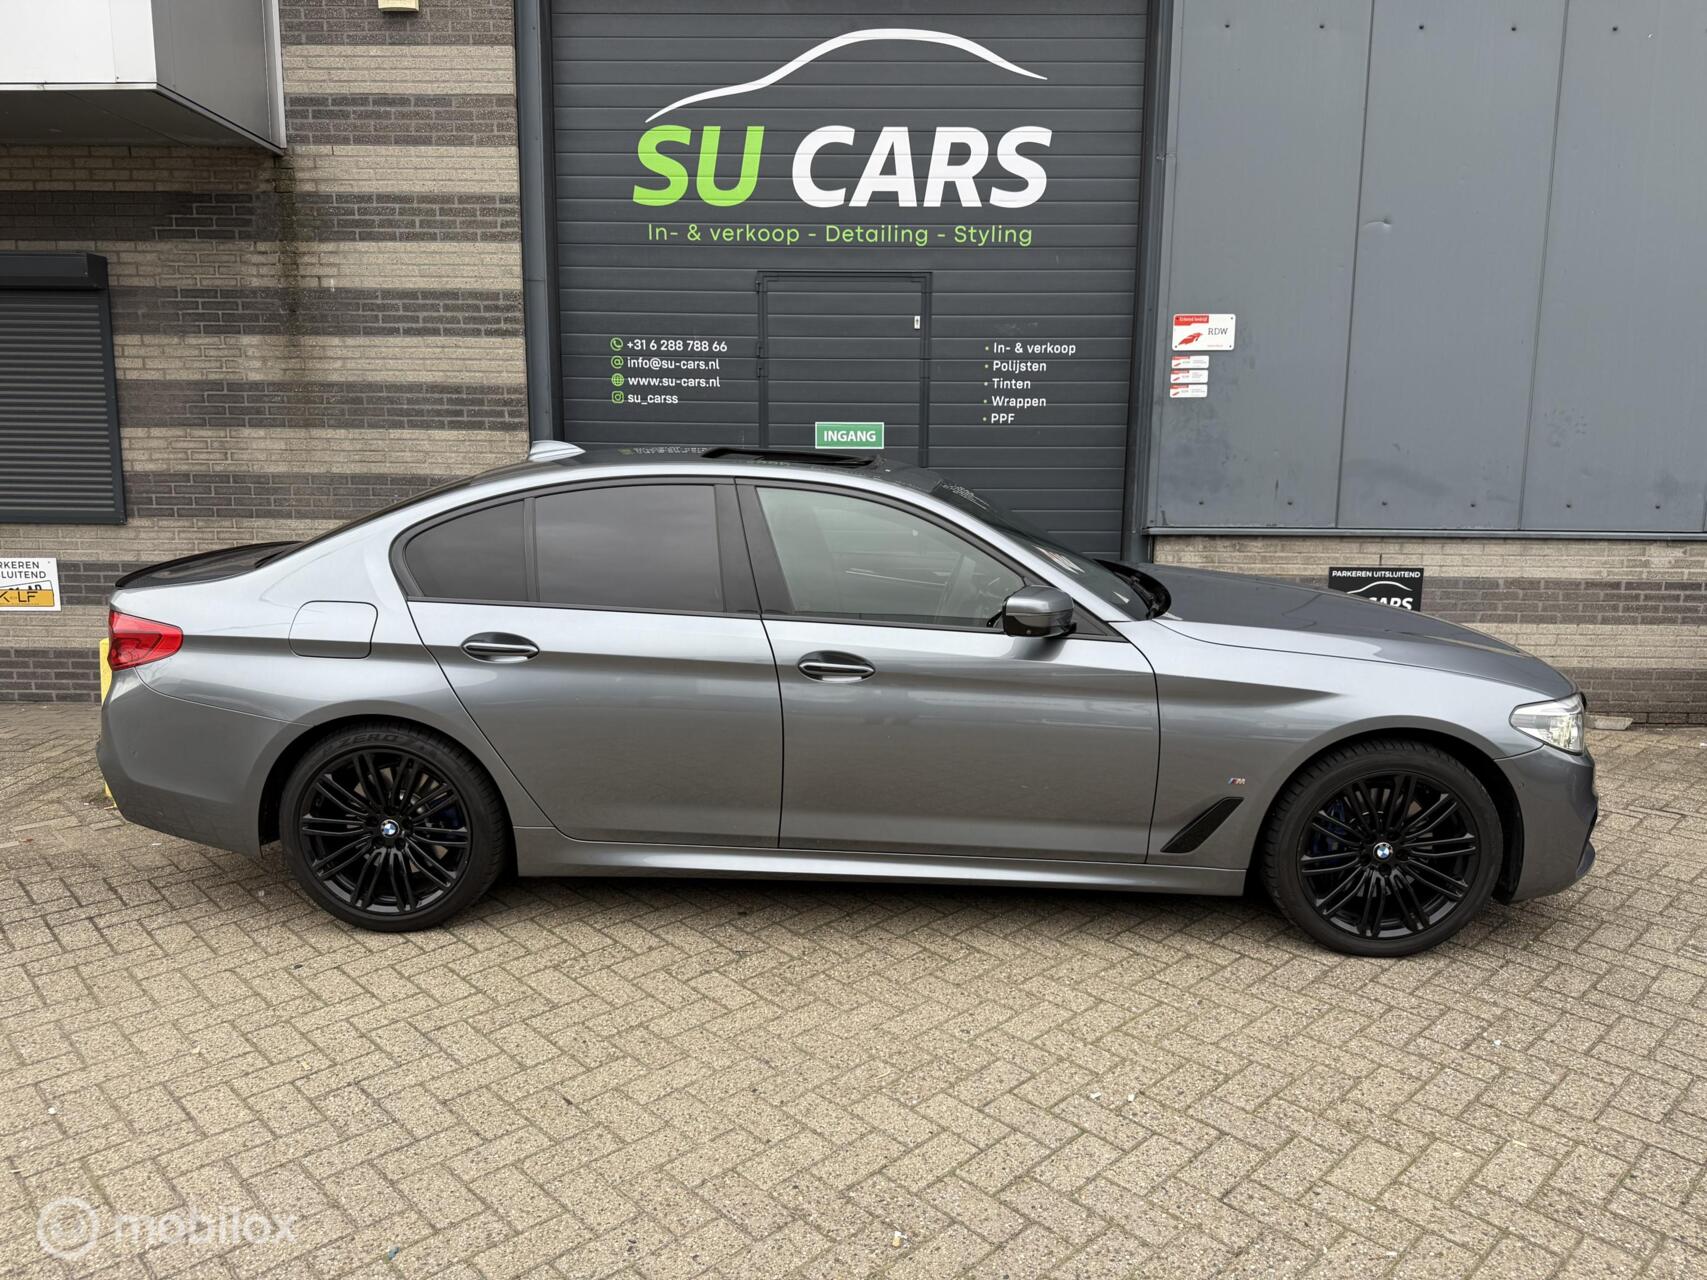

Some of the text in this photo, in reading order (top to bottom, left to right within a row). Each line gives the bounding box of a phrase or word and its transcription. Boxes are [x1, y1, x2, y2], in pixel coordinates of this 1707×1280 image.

[633, 124, 1053, 208] SU CARS
[648, 223, 679, 241] In-
[687, 224, 701, 241] &
[710, 223, 800, 246] verkoop
[825, 224, 928, 247] Detailing
[954, 224, 1032, 247] Styling
[1207, 327, 1229, 336] RDW
[627, 339, 728, 352] +31 6 288 788 66
[993, 342, 1076, 356] In- & verkoop
[627, 357, 720, 370] info@su-cars.nl
[993, 360, 1047, 374] Polijsten
[627, 376, 721, 387] www.su-cars.nl
[992, 378, 1031, 389] Tinten
[627, 393, 679, 405] su_carss
[991, 395, 1047, 409] Wrappen
[991, 413, 1015, 424] PPF
[823, 430, 877, 442] INGANG
